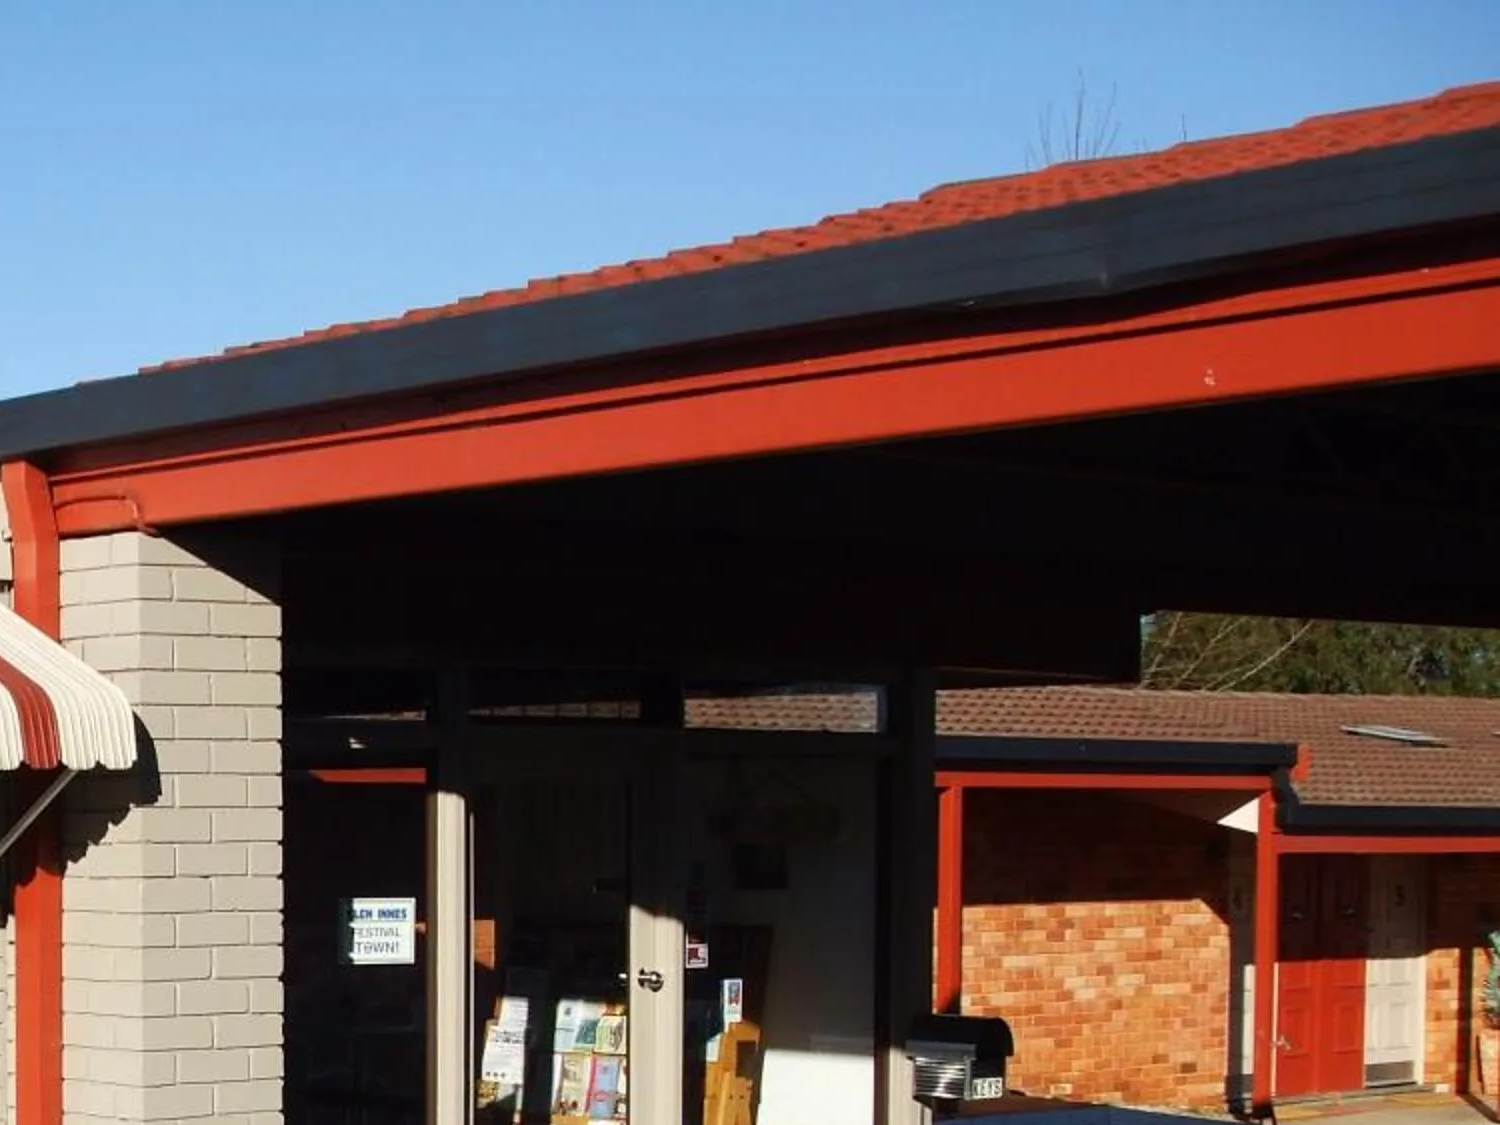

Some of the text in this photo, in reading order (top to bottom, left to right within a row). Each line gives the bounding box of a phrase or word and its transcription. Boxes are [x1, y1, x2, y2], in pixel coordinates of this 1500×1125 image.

[348, 908, 407, 919] LEN INNES
[355, 941, 400, 953] TOWN!
